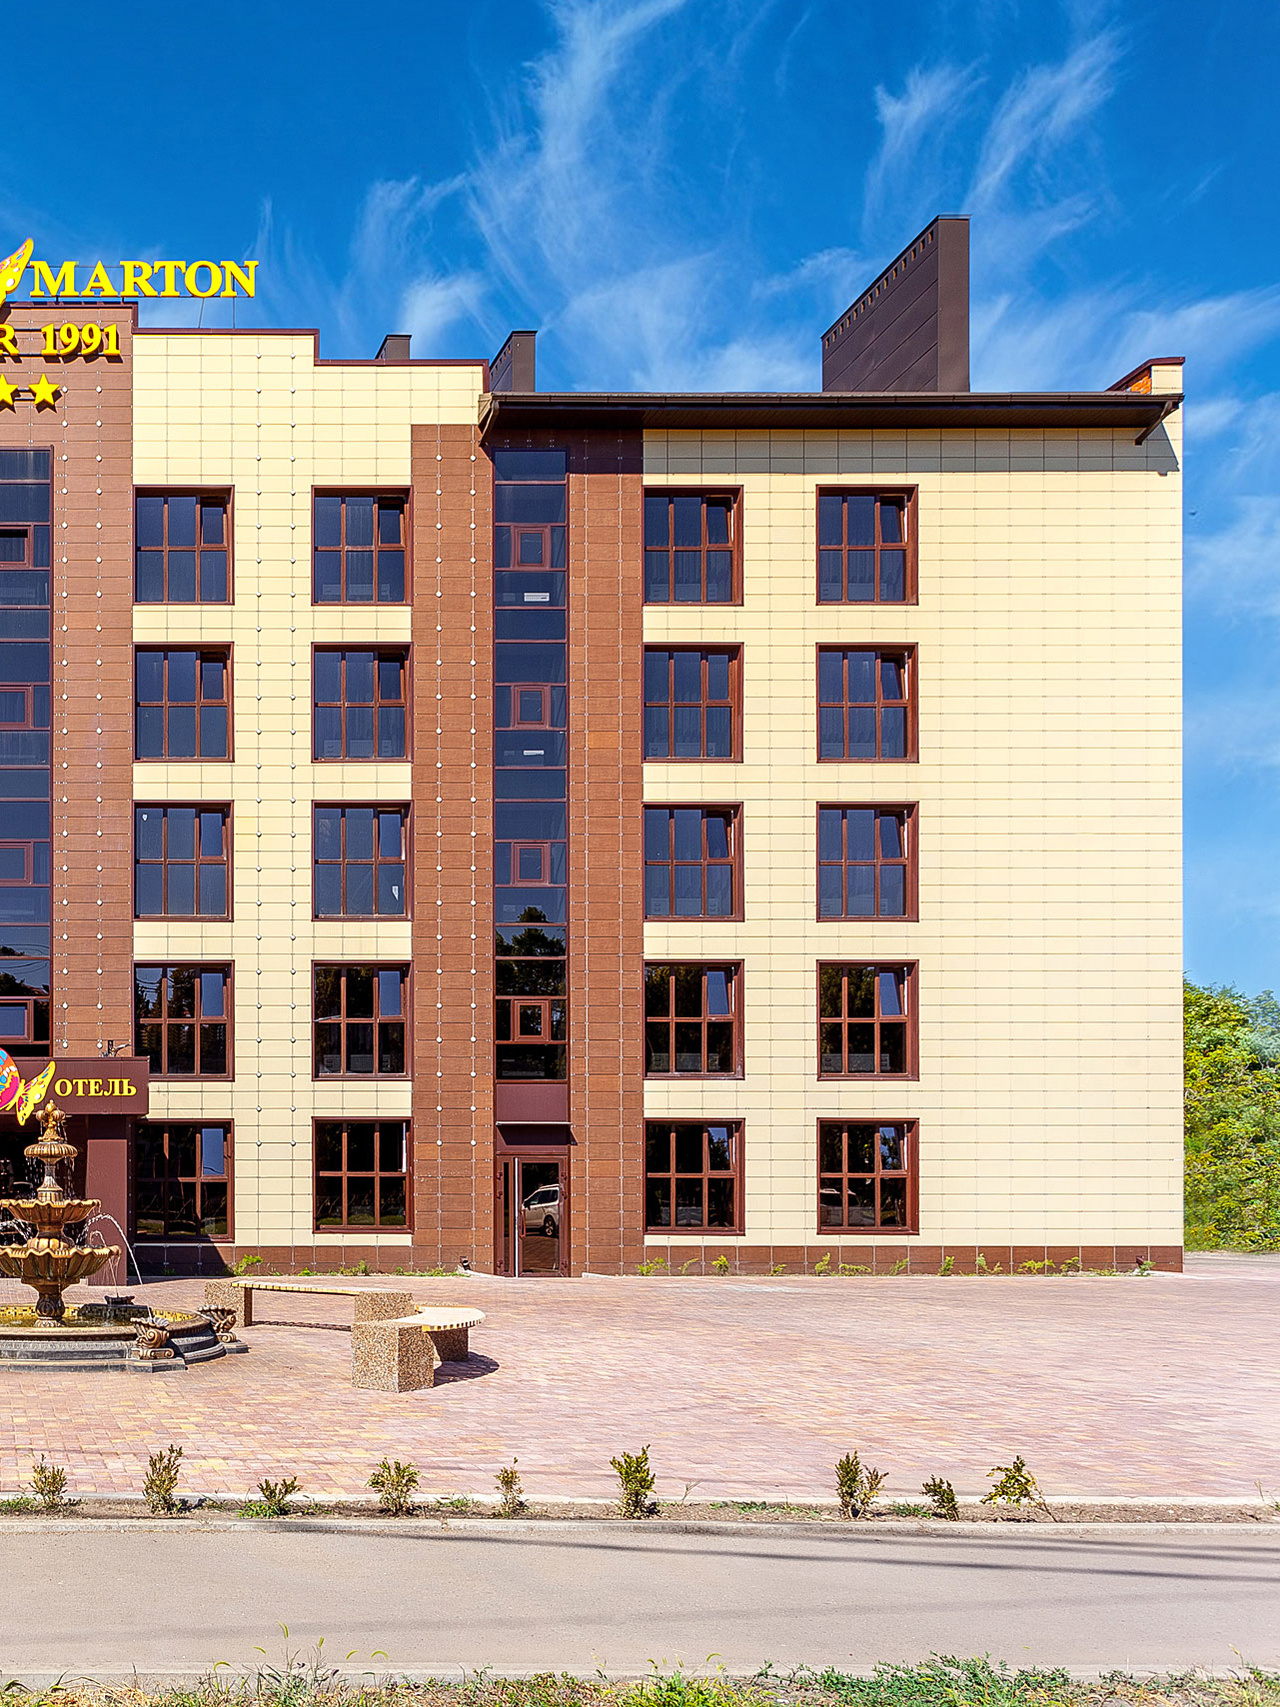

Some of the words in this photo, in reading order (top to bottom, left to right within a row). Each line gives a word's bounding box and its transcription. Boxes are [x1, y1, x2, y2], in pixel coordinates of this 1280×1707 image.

[30, 260, 259, 298] MARTON
[40, 323, 122, 357] 1991
[54, 1078, 137, 1097] ОТЕЛЬ
